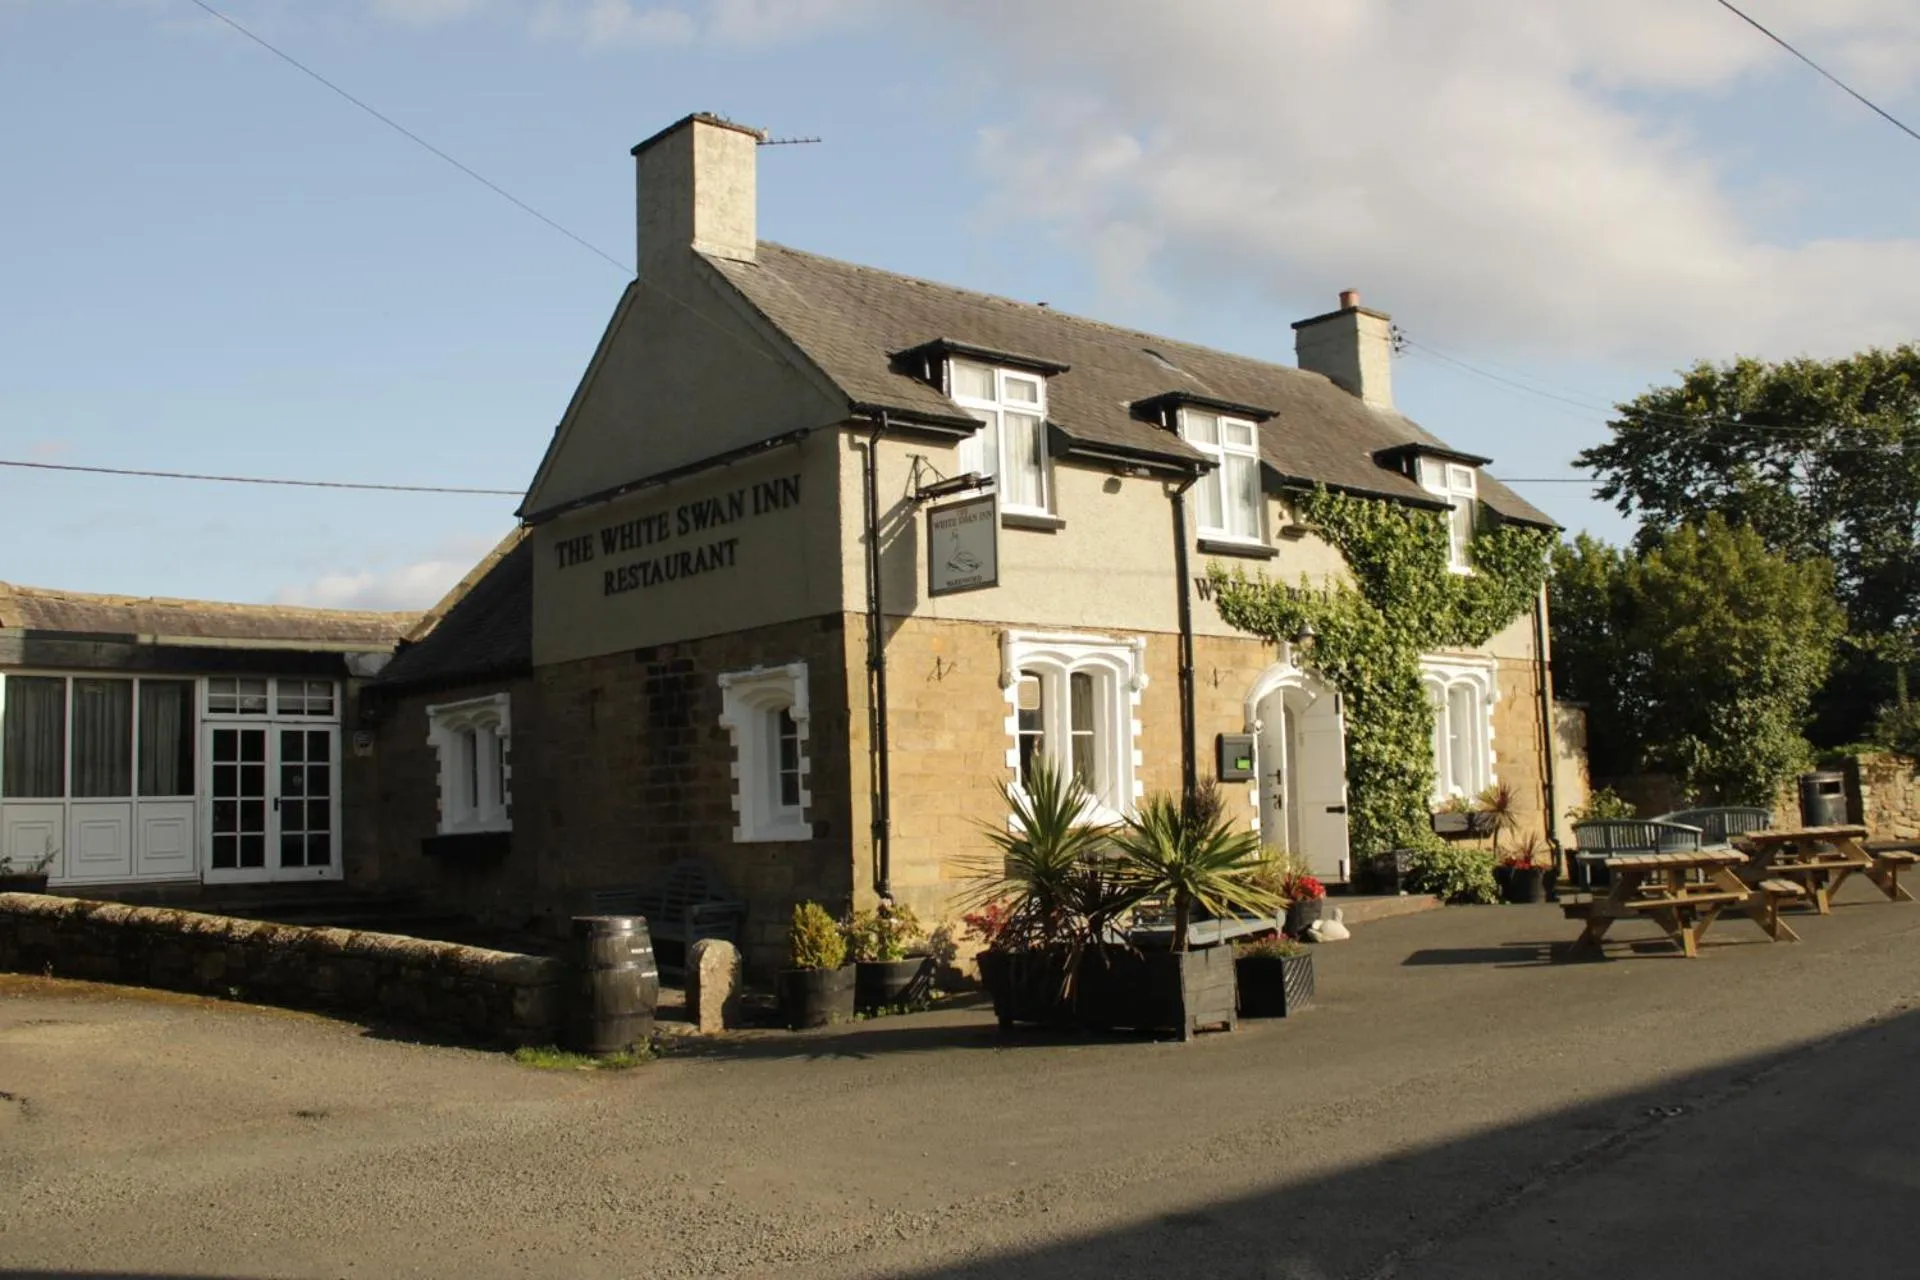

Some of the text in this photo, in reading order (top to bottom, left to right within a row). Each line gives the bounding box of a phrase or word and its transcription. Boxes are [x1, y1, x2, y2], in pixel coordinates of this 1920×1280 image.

[554, 474, 801, 569] THE WHITE SWAN INN
[604, 538, 739, 596] RESTAURANT
